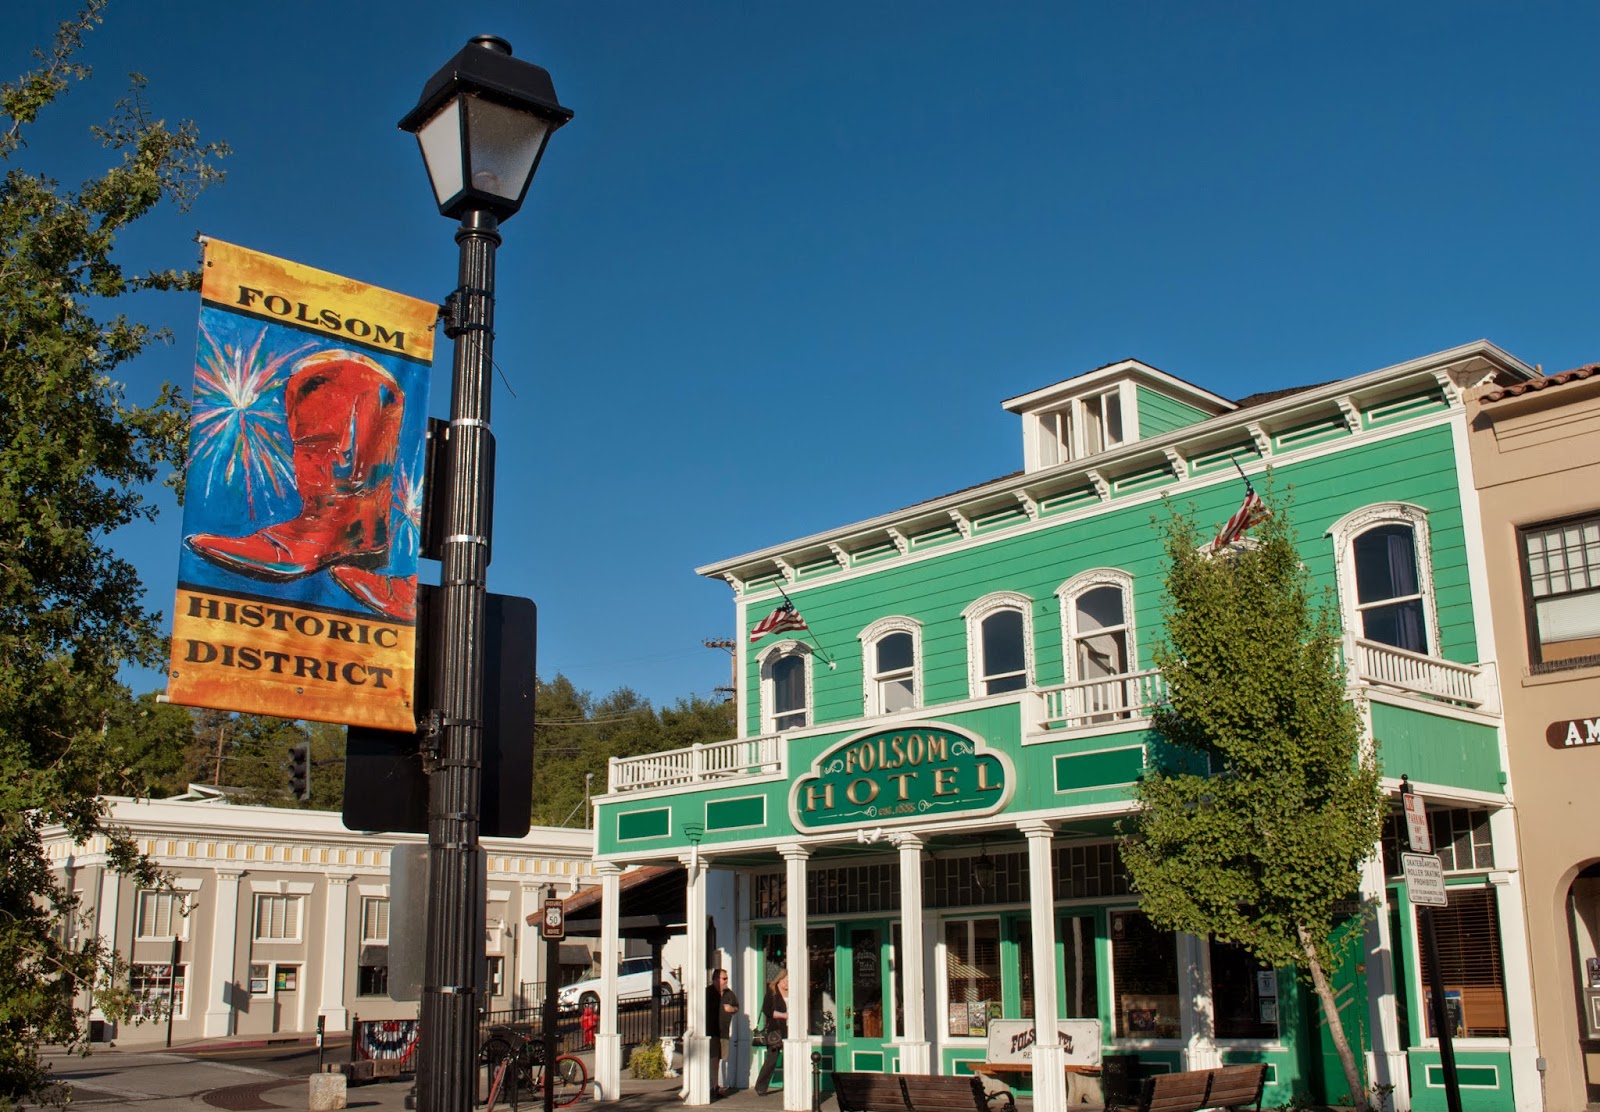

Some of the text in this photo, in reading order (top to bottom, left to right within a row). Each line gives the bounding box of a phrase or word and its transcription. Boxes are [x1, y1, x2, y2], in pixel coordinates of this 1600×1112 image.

[236, 285, 405, 350] FOLSOM
[187, 596, 398, 649] HISTORIC
[184, 639, 393, 689] DISTRICT
[845, 734, 948, 775] FOLSOM
[805, 762, 1002, 812] HOTEL
[1408, 812, 1425, 826] PARKING
[1414, 825, 1422, 834] ANY
[1415, 835, 1424, 844] TIME
[1406, 859, 1439, 869] SKATEBOARDING
[1407, 868, 1441, 878] ROLLER SKATING
[1413, 877, 1438, 887] PROHIBITED
[549, 916, 558, 925] 50
[1010, 1028, 1036, 1054] FOLS
